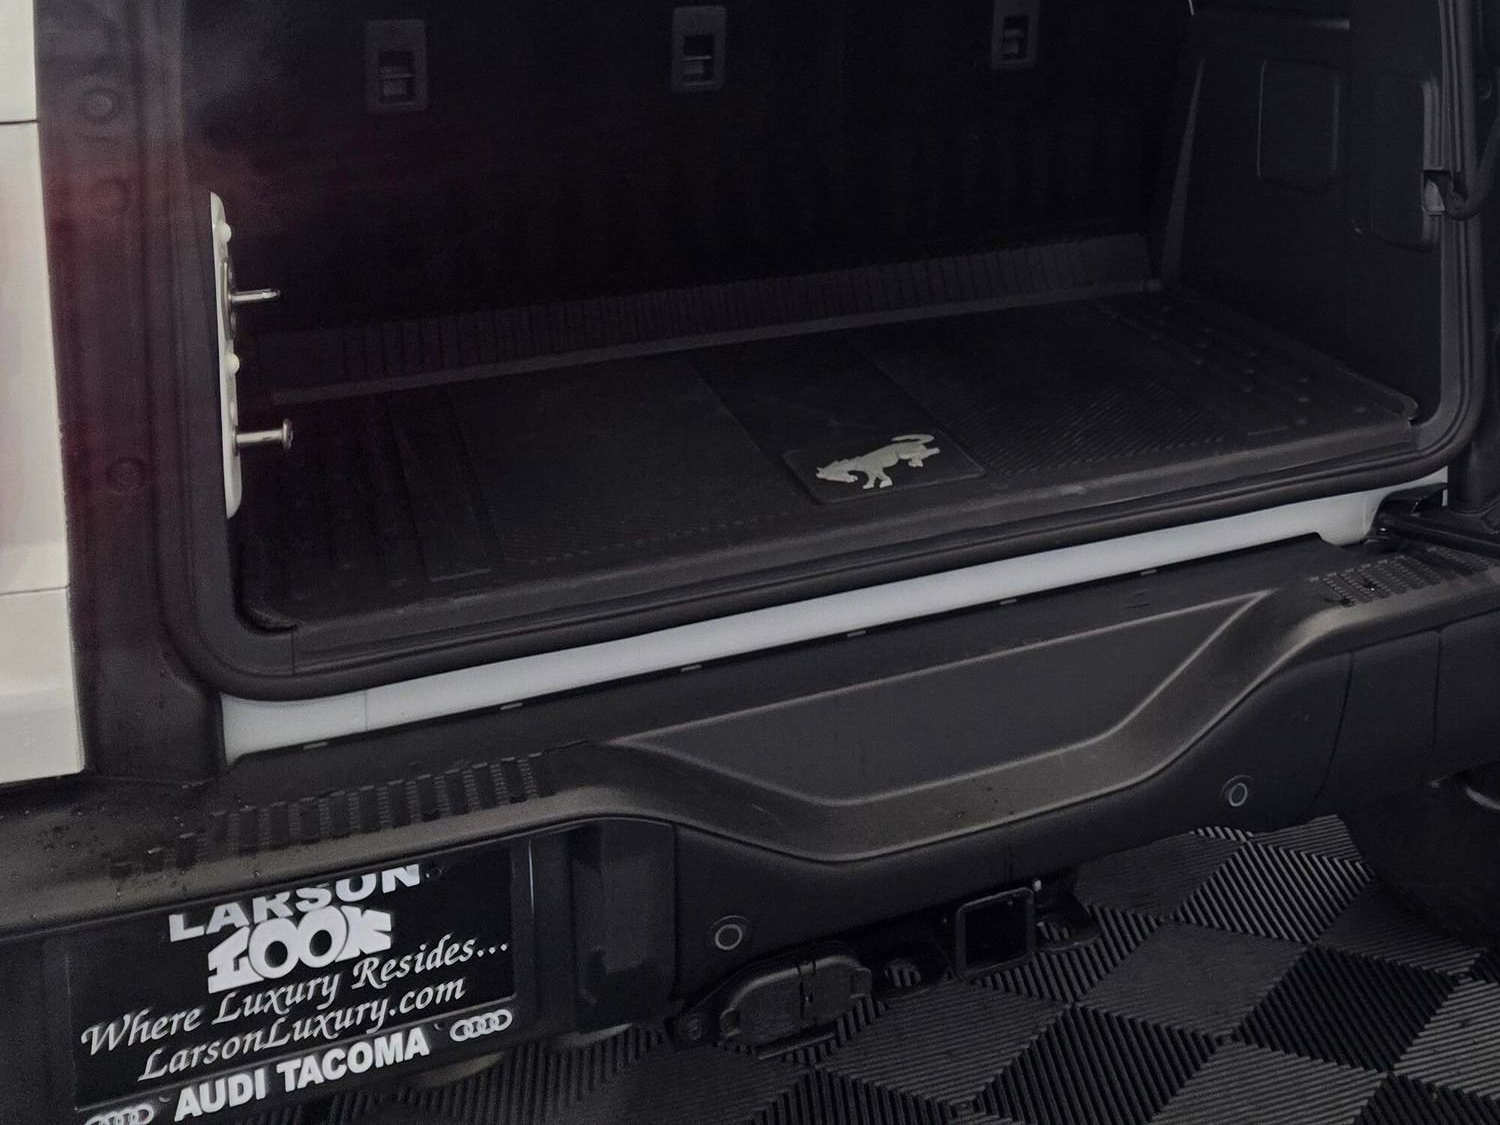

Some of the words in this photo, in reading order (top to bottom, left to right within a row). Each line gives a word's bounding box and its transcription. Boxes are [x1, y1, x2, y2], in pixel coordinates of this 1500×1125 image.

[169, 864, 420, 942] LARSON
[81, 1008, 203, 1055] Where
[212, 973, 341, 1024] Luxury
[351, 934, 508, 989] Resides...
[138, 978, 466, 1081] LarsonLuxury.com
[175, 1069, 266, 1122] AUDI
[277, 1027, 430, 1092] TACOMA
